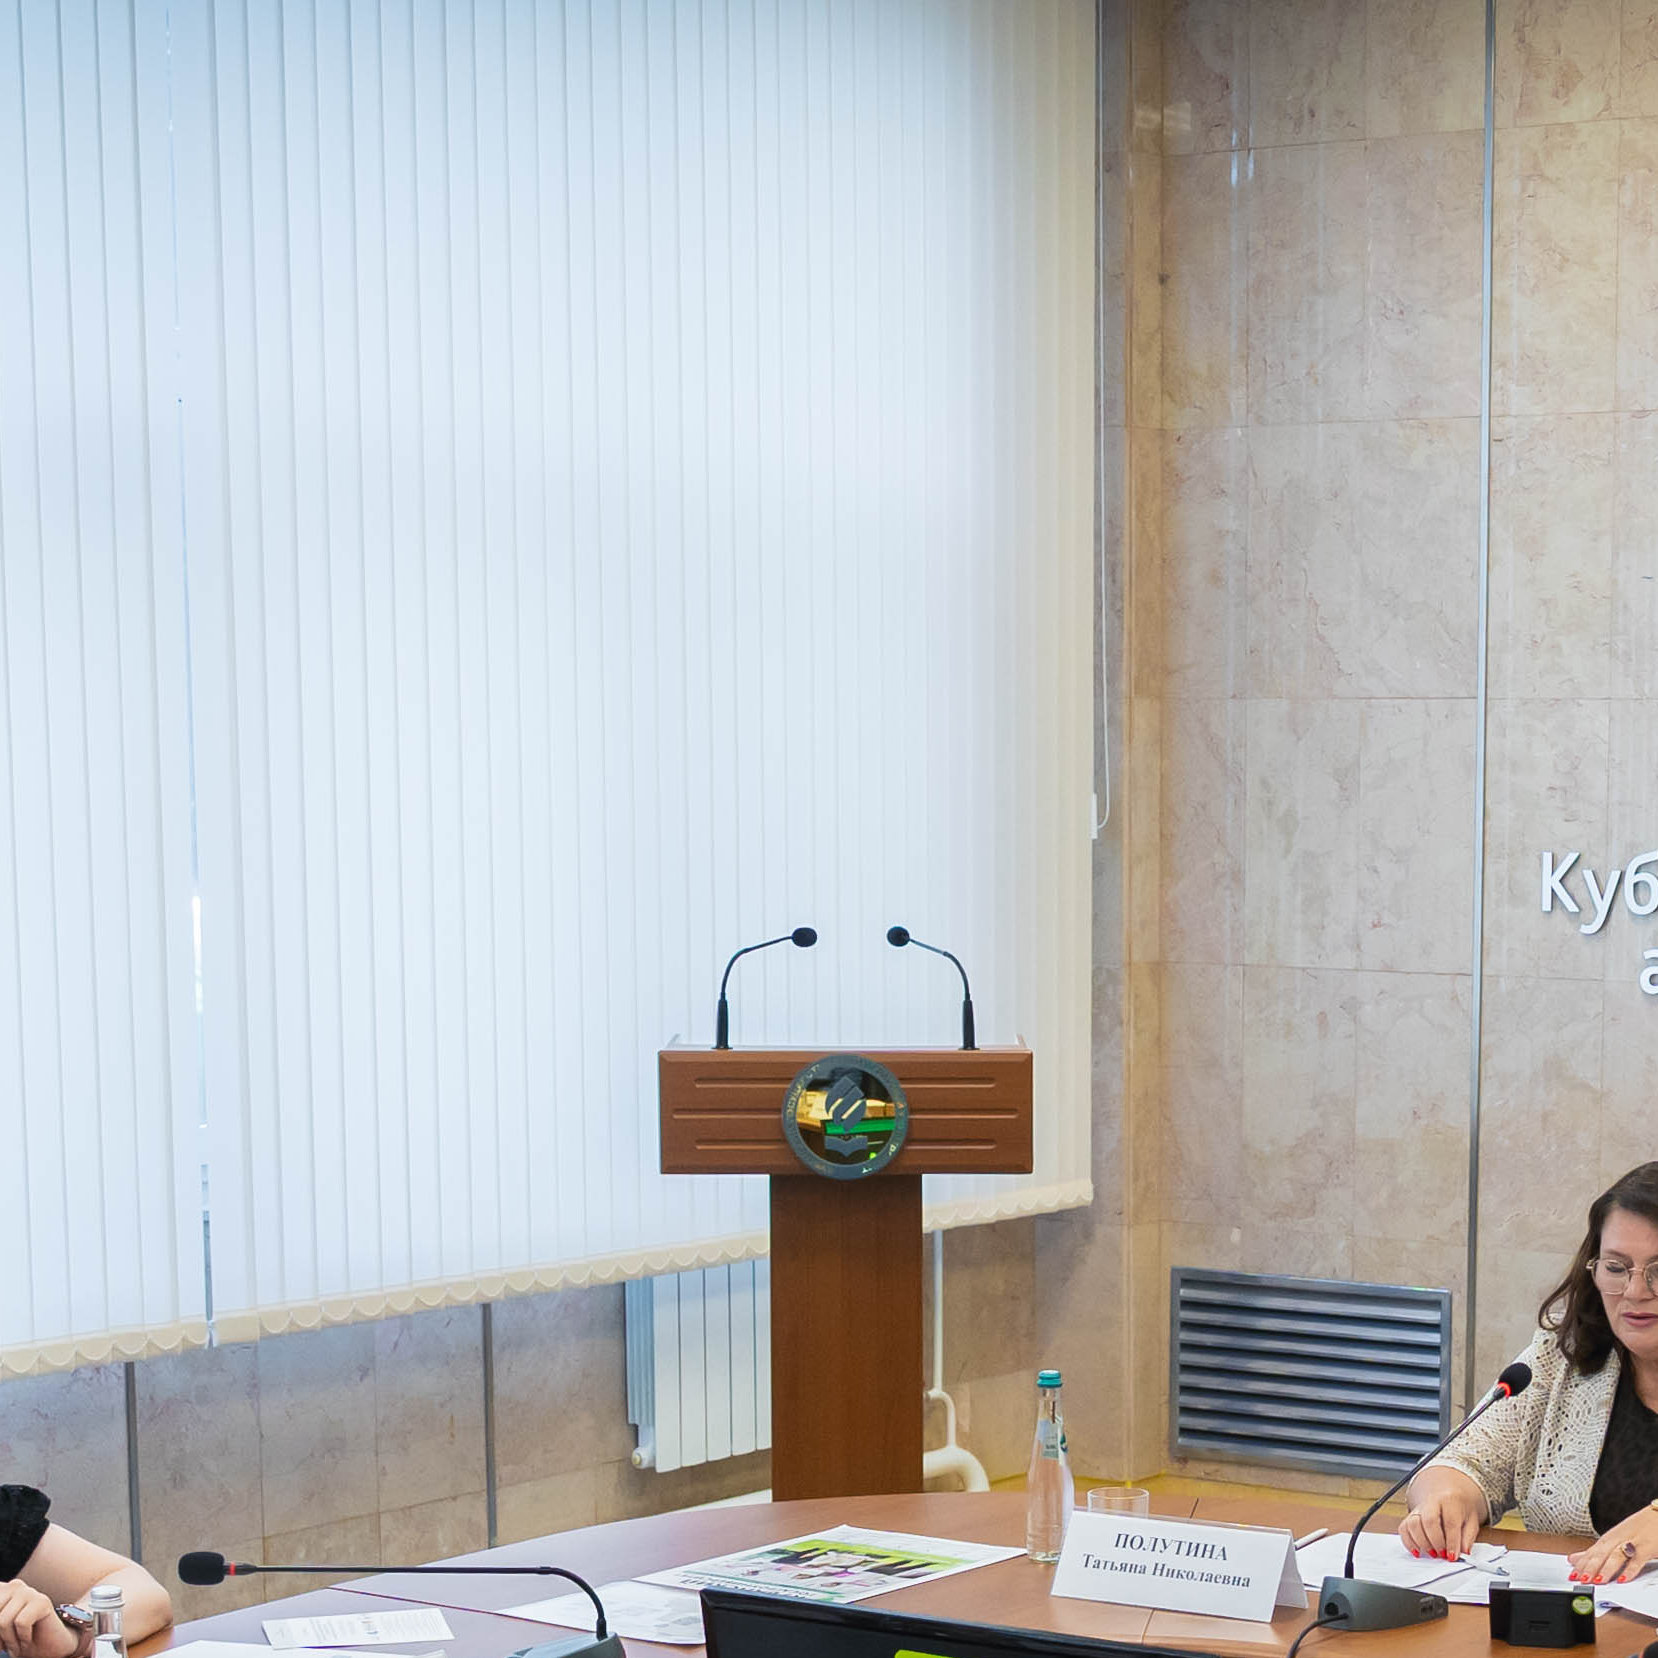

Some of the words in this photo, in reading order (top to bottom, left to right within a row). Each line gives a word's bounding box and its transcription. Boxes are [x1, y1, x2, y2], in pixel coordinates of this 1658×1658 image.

[1114, 1532, 1229, 1562] ПОЛУТИНА
[1082, 1552, 1147, 1576] Татьяна
[1151, 1561, 1251, 1589] Николаевна
